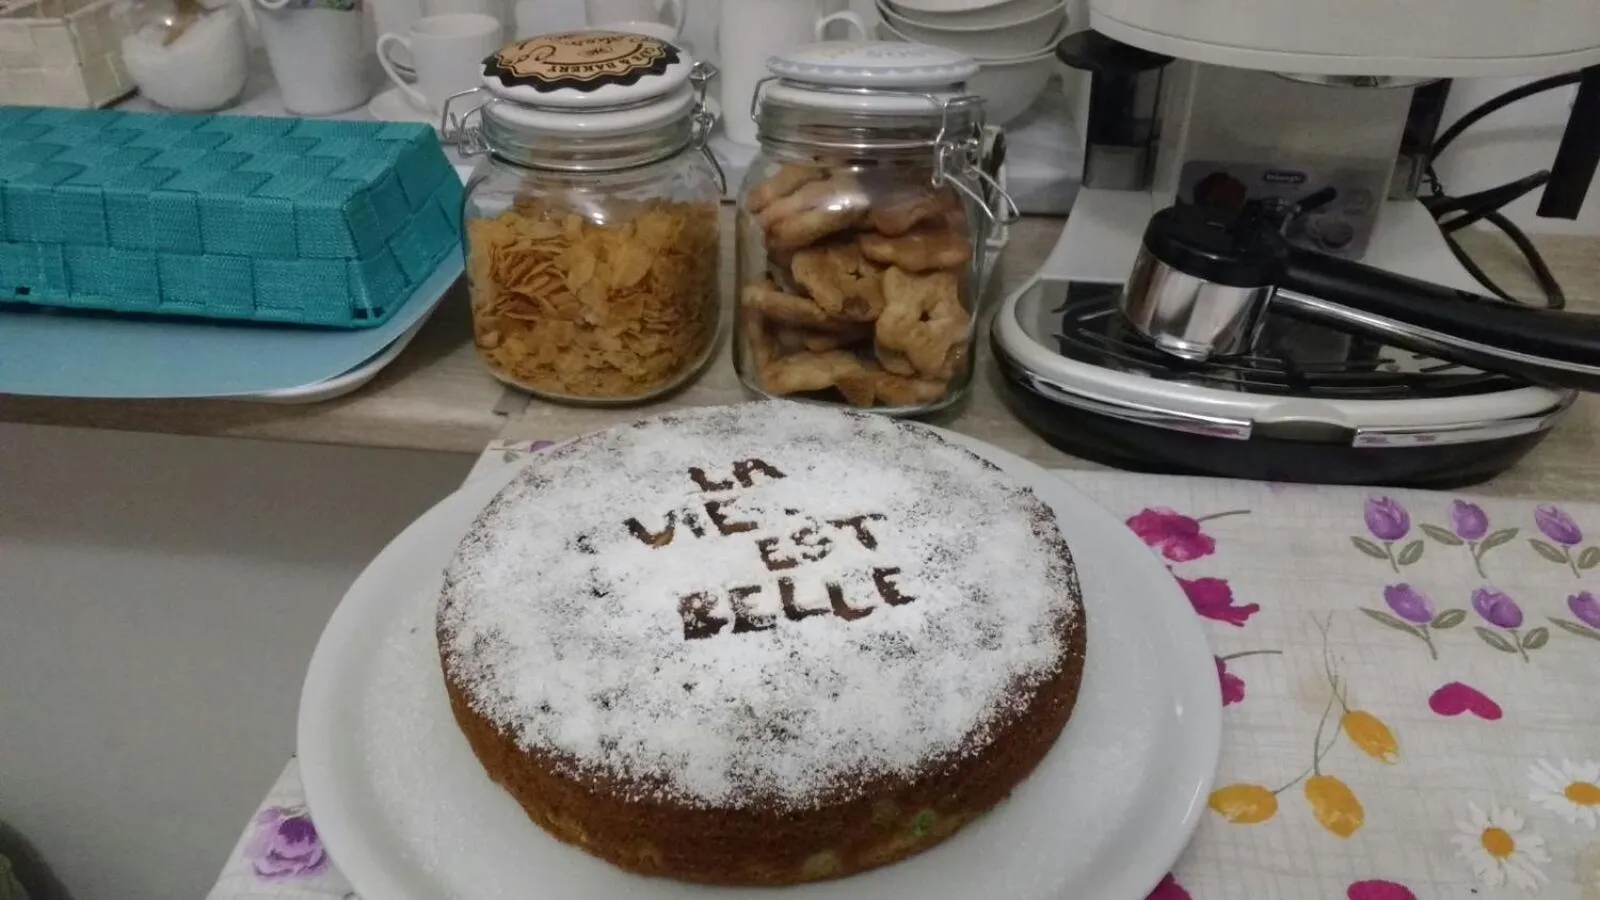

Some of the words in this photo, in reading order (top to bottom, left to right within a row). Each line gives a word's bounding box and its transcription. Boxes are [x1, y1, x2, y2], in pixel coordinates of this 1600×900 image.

[547, 61, 617, 74] BAKERY
[688, 457, 787, 492] LA
[623, 499, 759, 550] VIE
[755, 513, 888, 572] EST
[678, 567, 916, 641] BELLE
